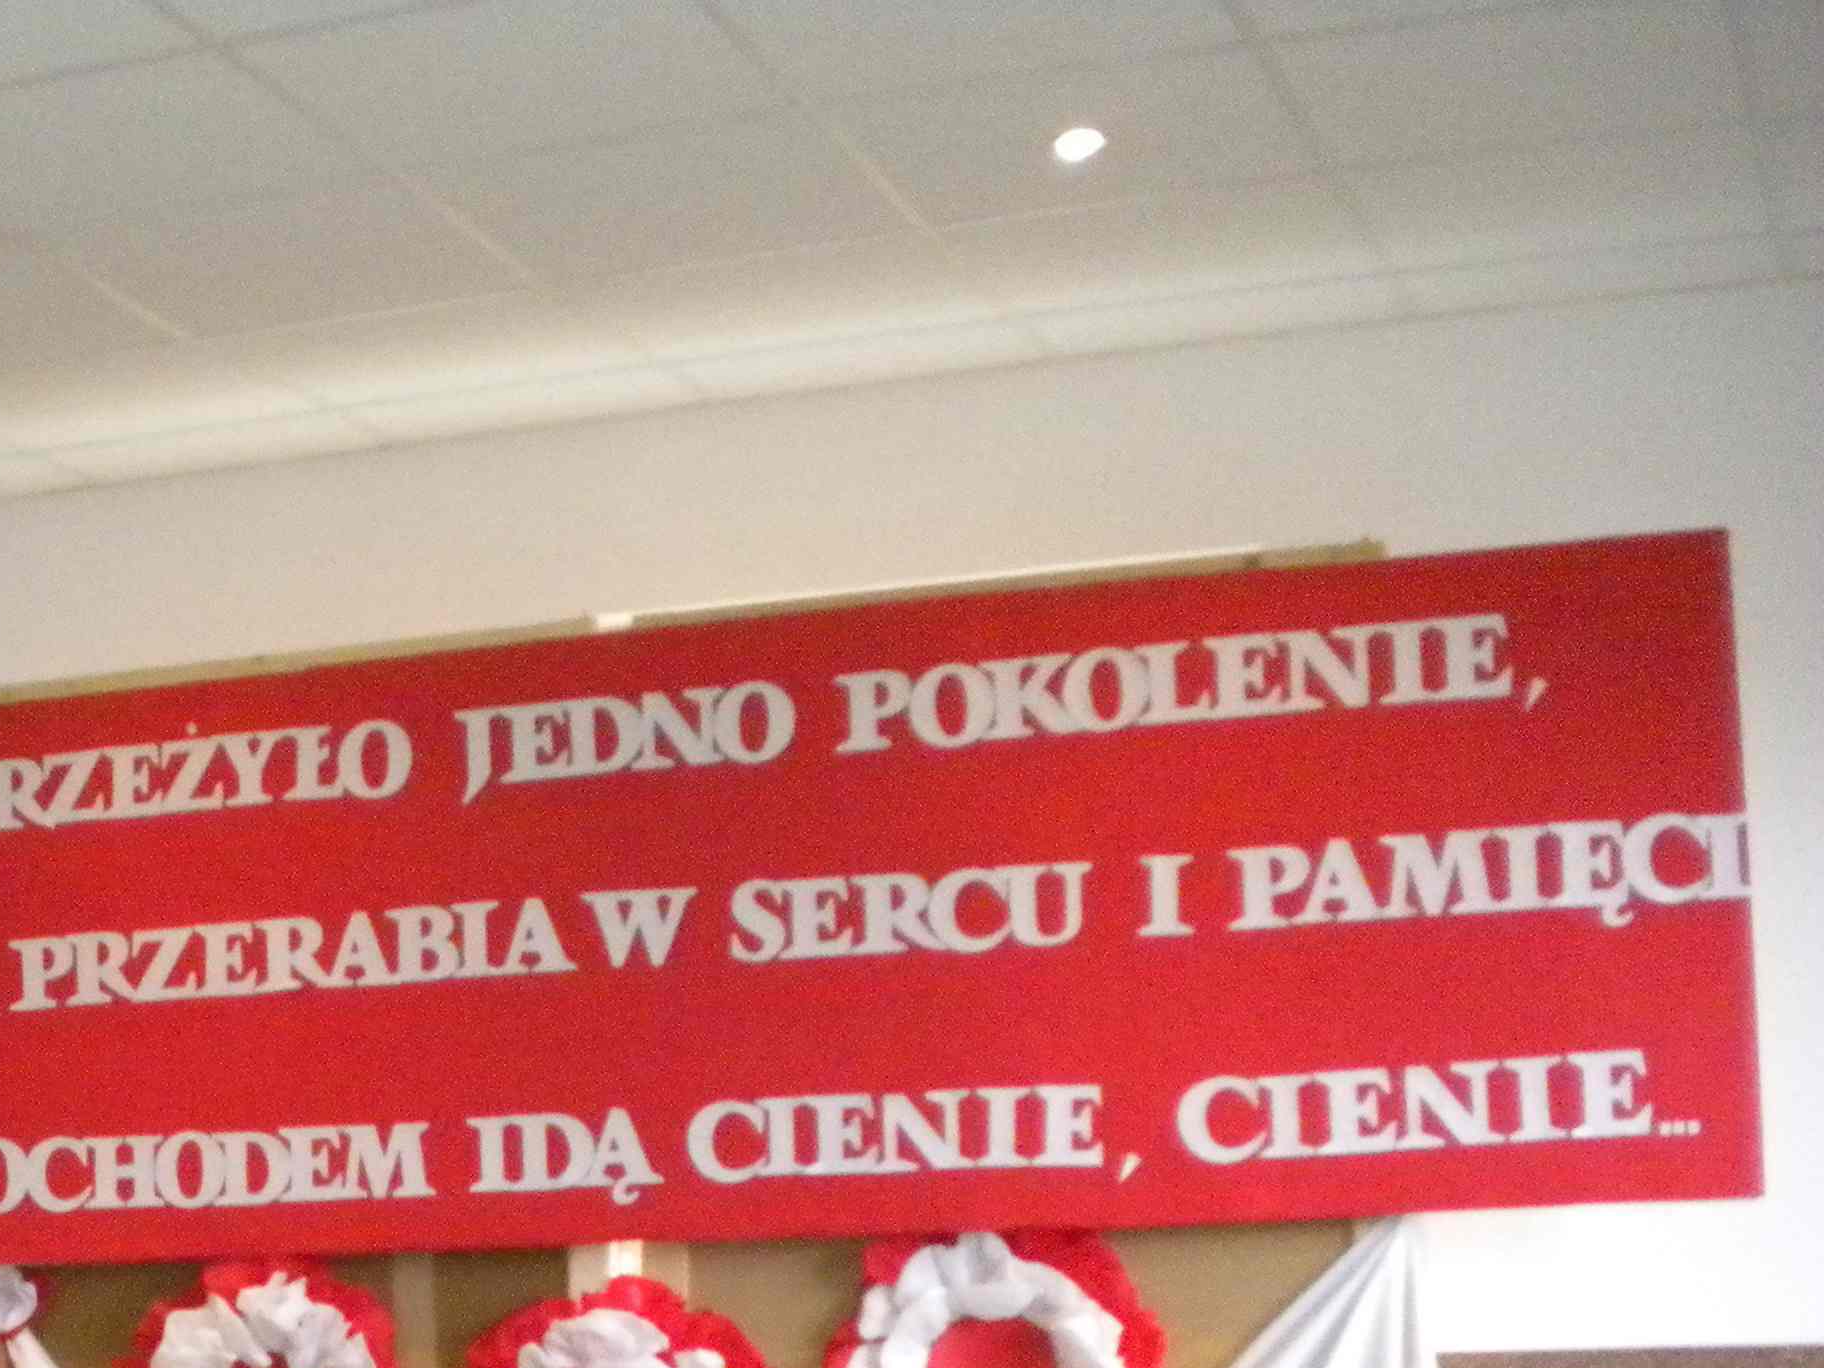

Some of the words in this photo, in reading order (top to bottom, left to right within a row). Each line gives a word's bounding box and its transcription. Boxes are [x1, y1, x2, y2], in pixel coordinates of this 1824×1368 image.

[453, 681, 796, 805] JEDNO
[835, 613, 1549, 756] POKOLENIE,
[7, 896, 578, 1013] PRZERABIA
[580, 886, 699, 969] W
[728, 862, 1090, 965] SERCU
[1138, 852, 1194, 938] I
[1226, 811, 1753, 930] PAMIĘCI
[466, 1106, 664, 1205] IDĄ
[686, 1082, 1142, 1185] CIENIE,
[1175, 1047, 1701, 1165] CIENIE...
